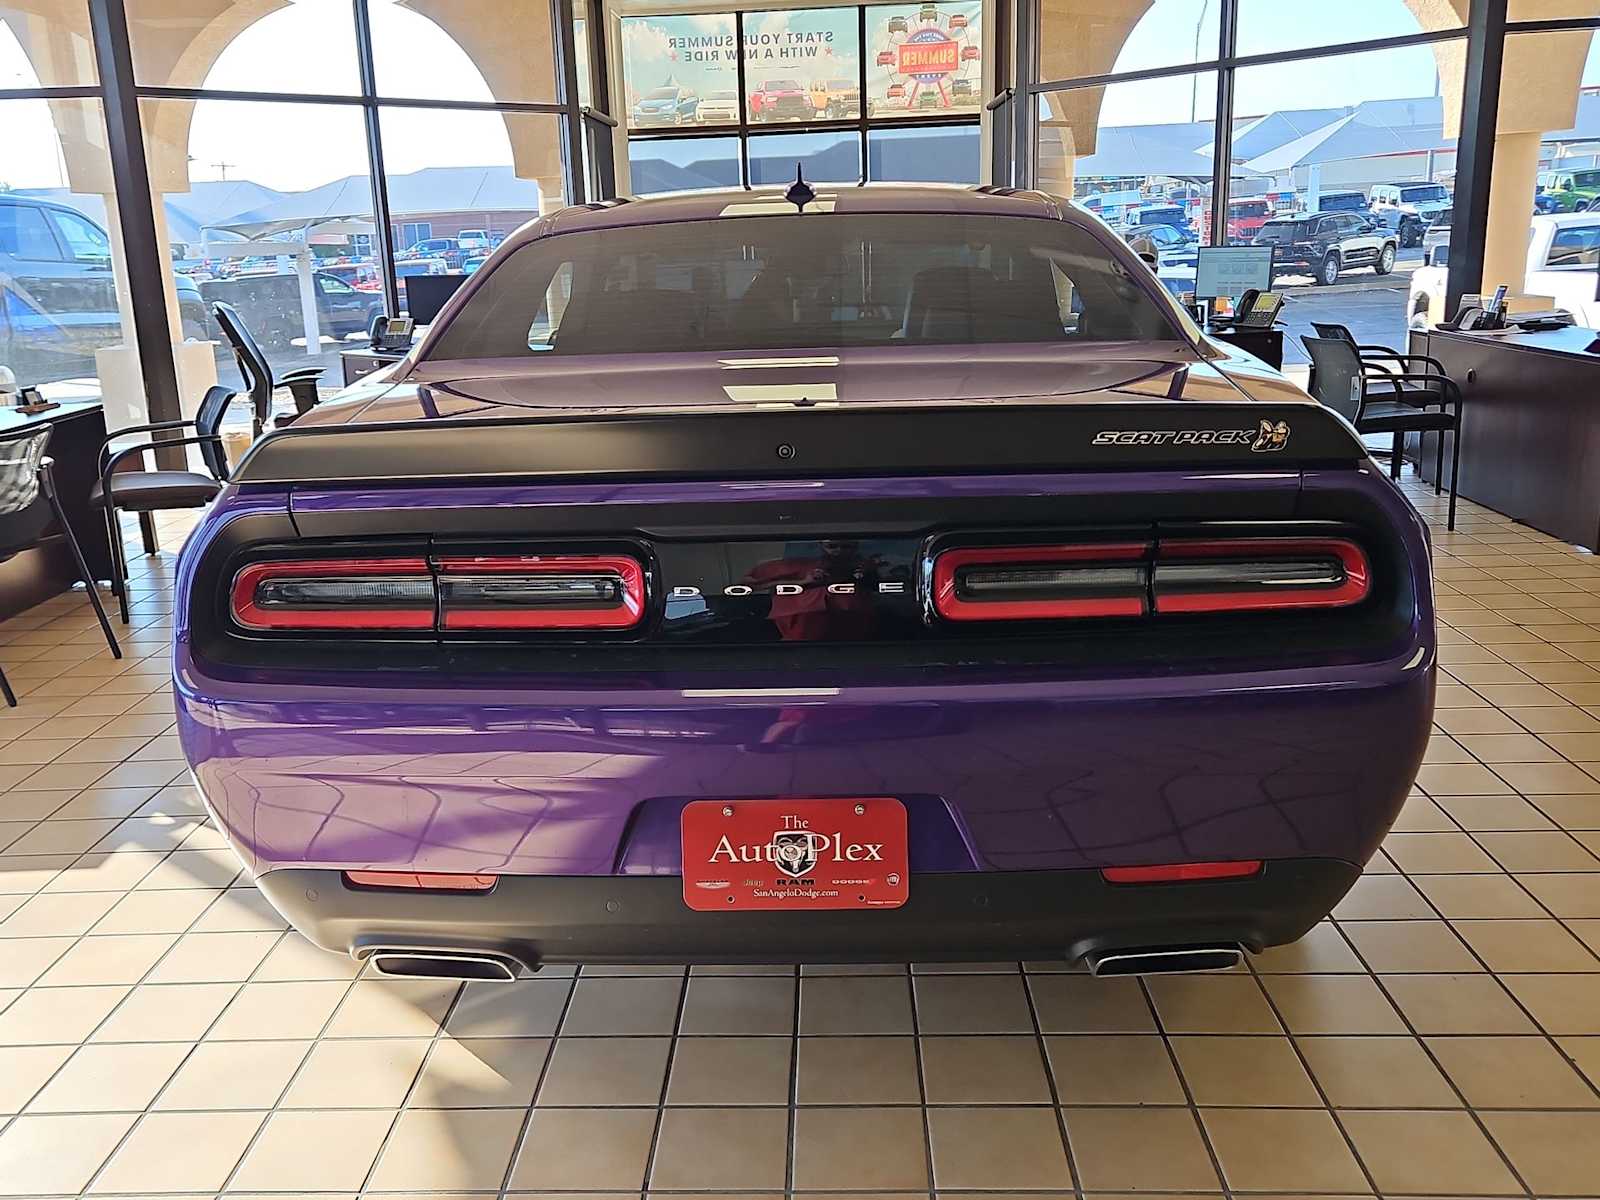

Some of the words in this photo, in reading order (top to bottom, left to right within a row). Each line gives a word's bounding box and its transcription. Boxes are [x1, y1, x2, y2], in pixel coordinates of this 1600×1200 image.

[1092, 431, 1176, 445] SCAT
[1173, 430, 1257, 444] PACK
[673, 582, 905, 597] DODGE
[780, 815, 809, 829] The
[708, 832, 884, 863] AutoPlex
[776, 878, 816, 886] RAM
[753, 888, 839, 899] SanAngeloDodge.com
